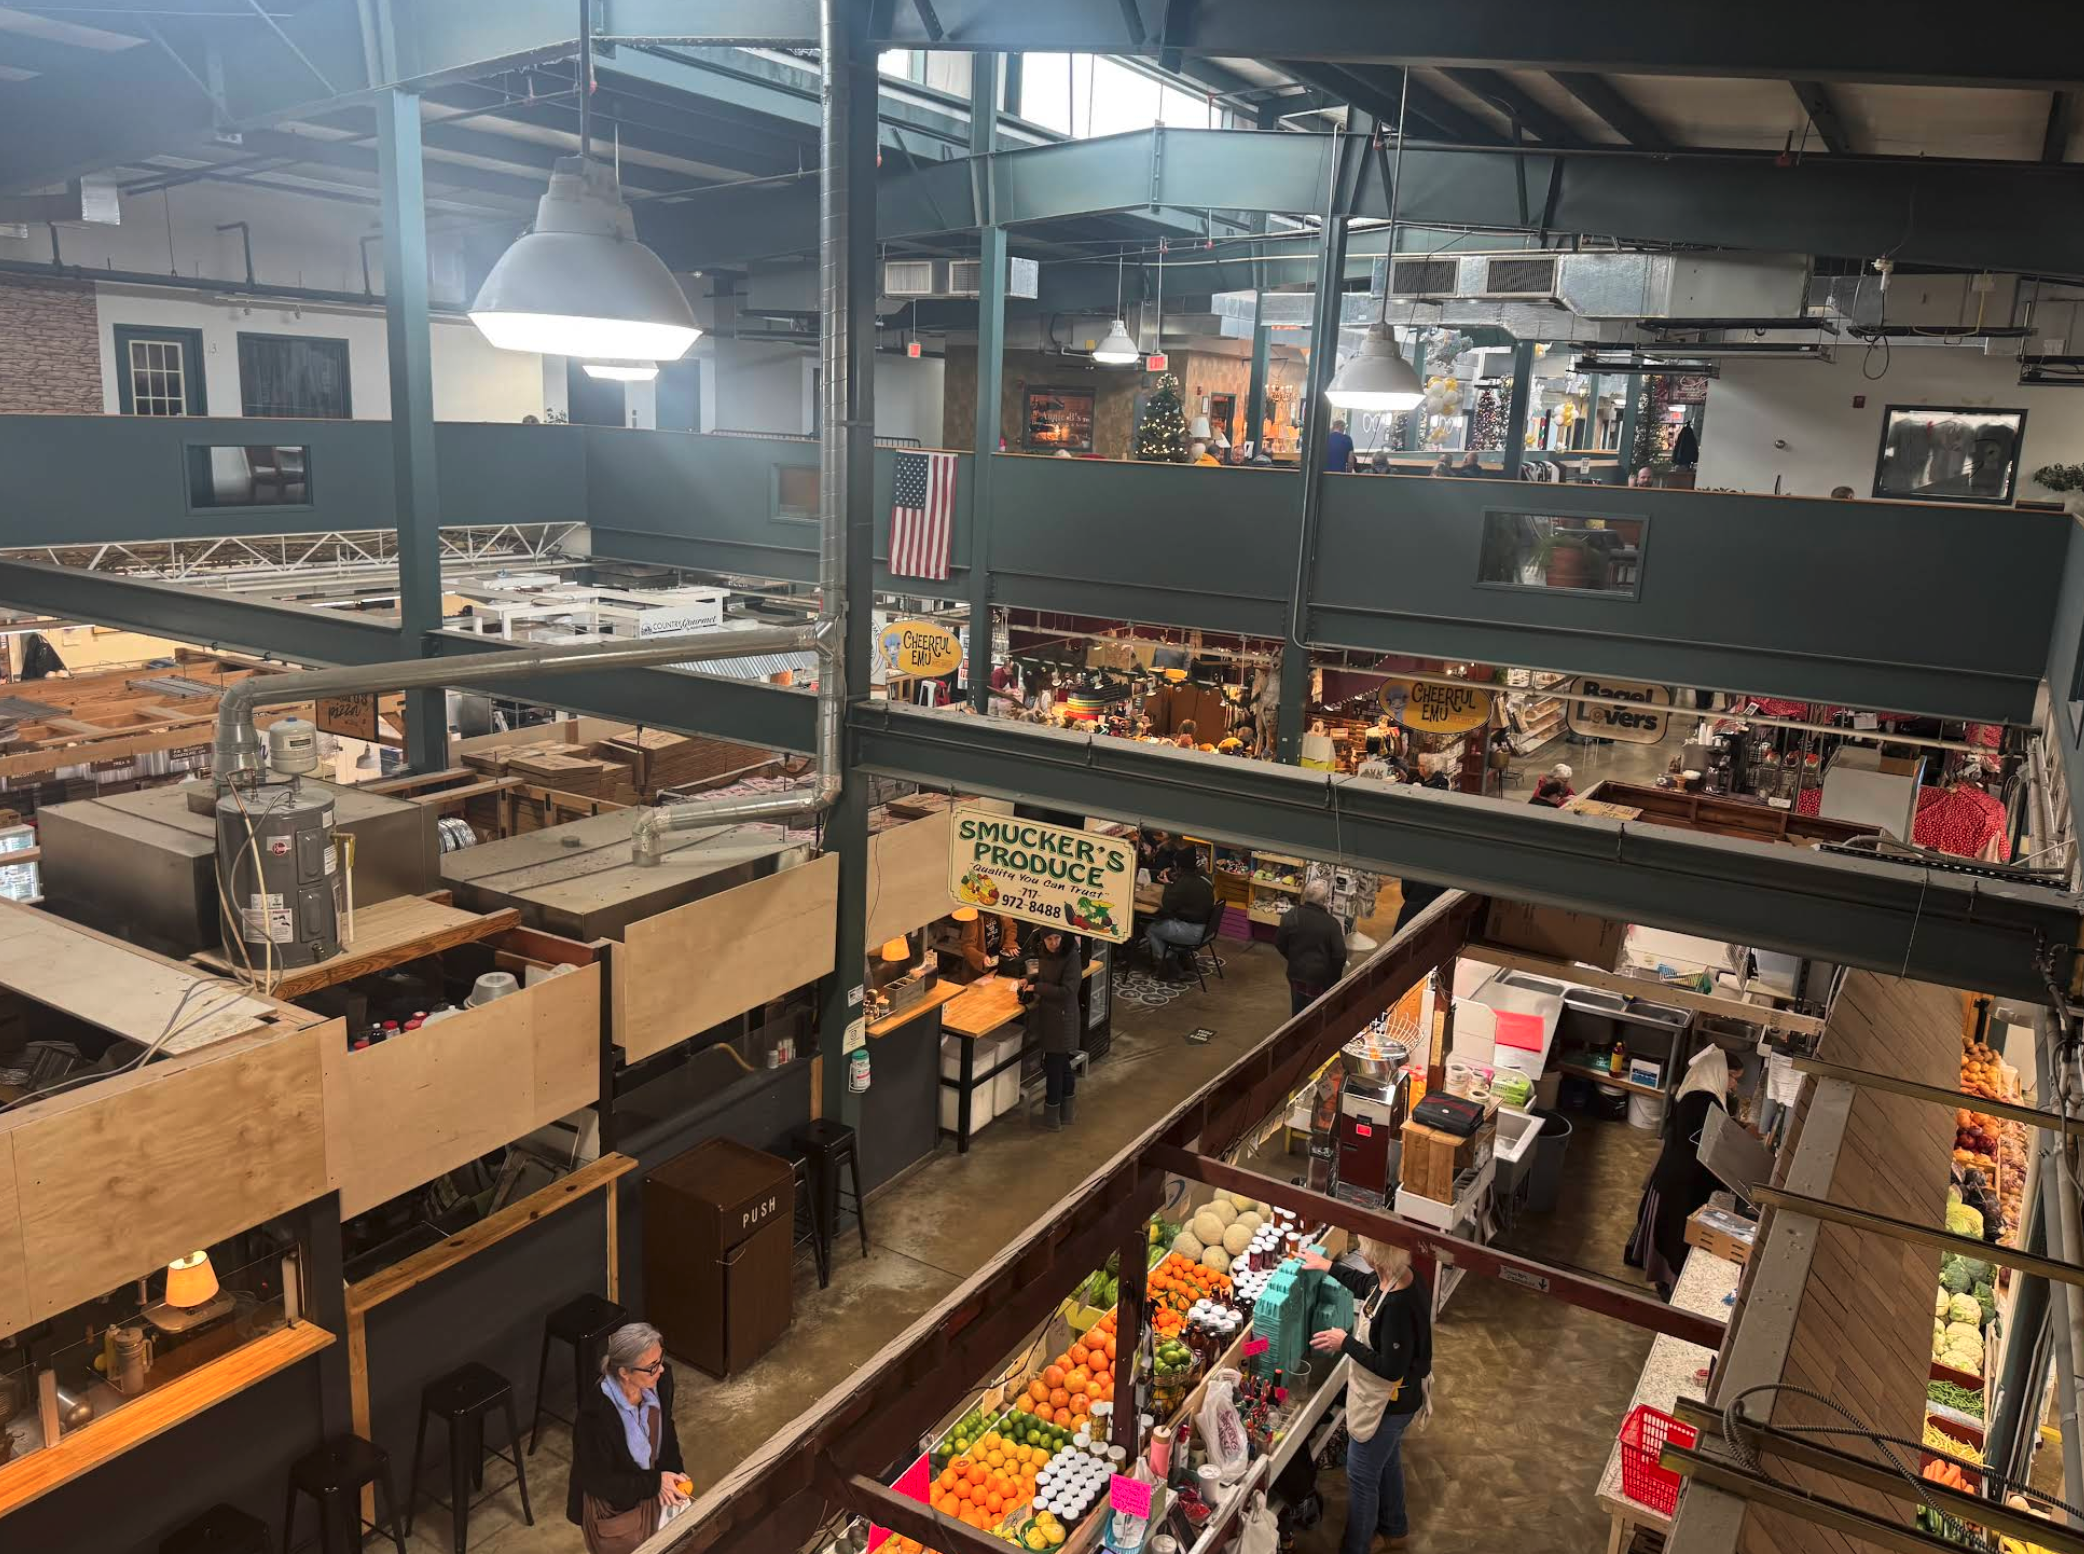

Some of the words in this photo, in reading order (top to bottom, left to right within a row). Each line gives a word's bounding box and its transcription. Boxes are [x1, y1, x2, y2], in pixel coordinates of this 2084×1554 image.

[653, 618, 681, 630] COUNTRY
[911, 650, 931, 666] EMU
[1583, 681, 1653, 710] Bagel
[1421, 704, 1448, 722] EMU
[1576, 700, 1658, 730] Lovers
[959, 820, 1125, 873] SMUCKER'S
[973, 842, 1104, 888] PRODUCE
[1019, 873, 1039, 885] You
[1043, 879, 1065, 891] Can
[1001, 894, 1061, 918] 972-8488
[742, 1196, 776, 1229] PUSH
